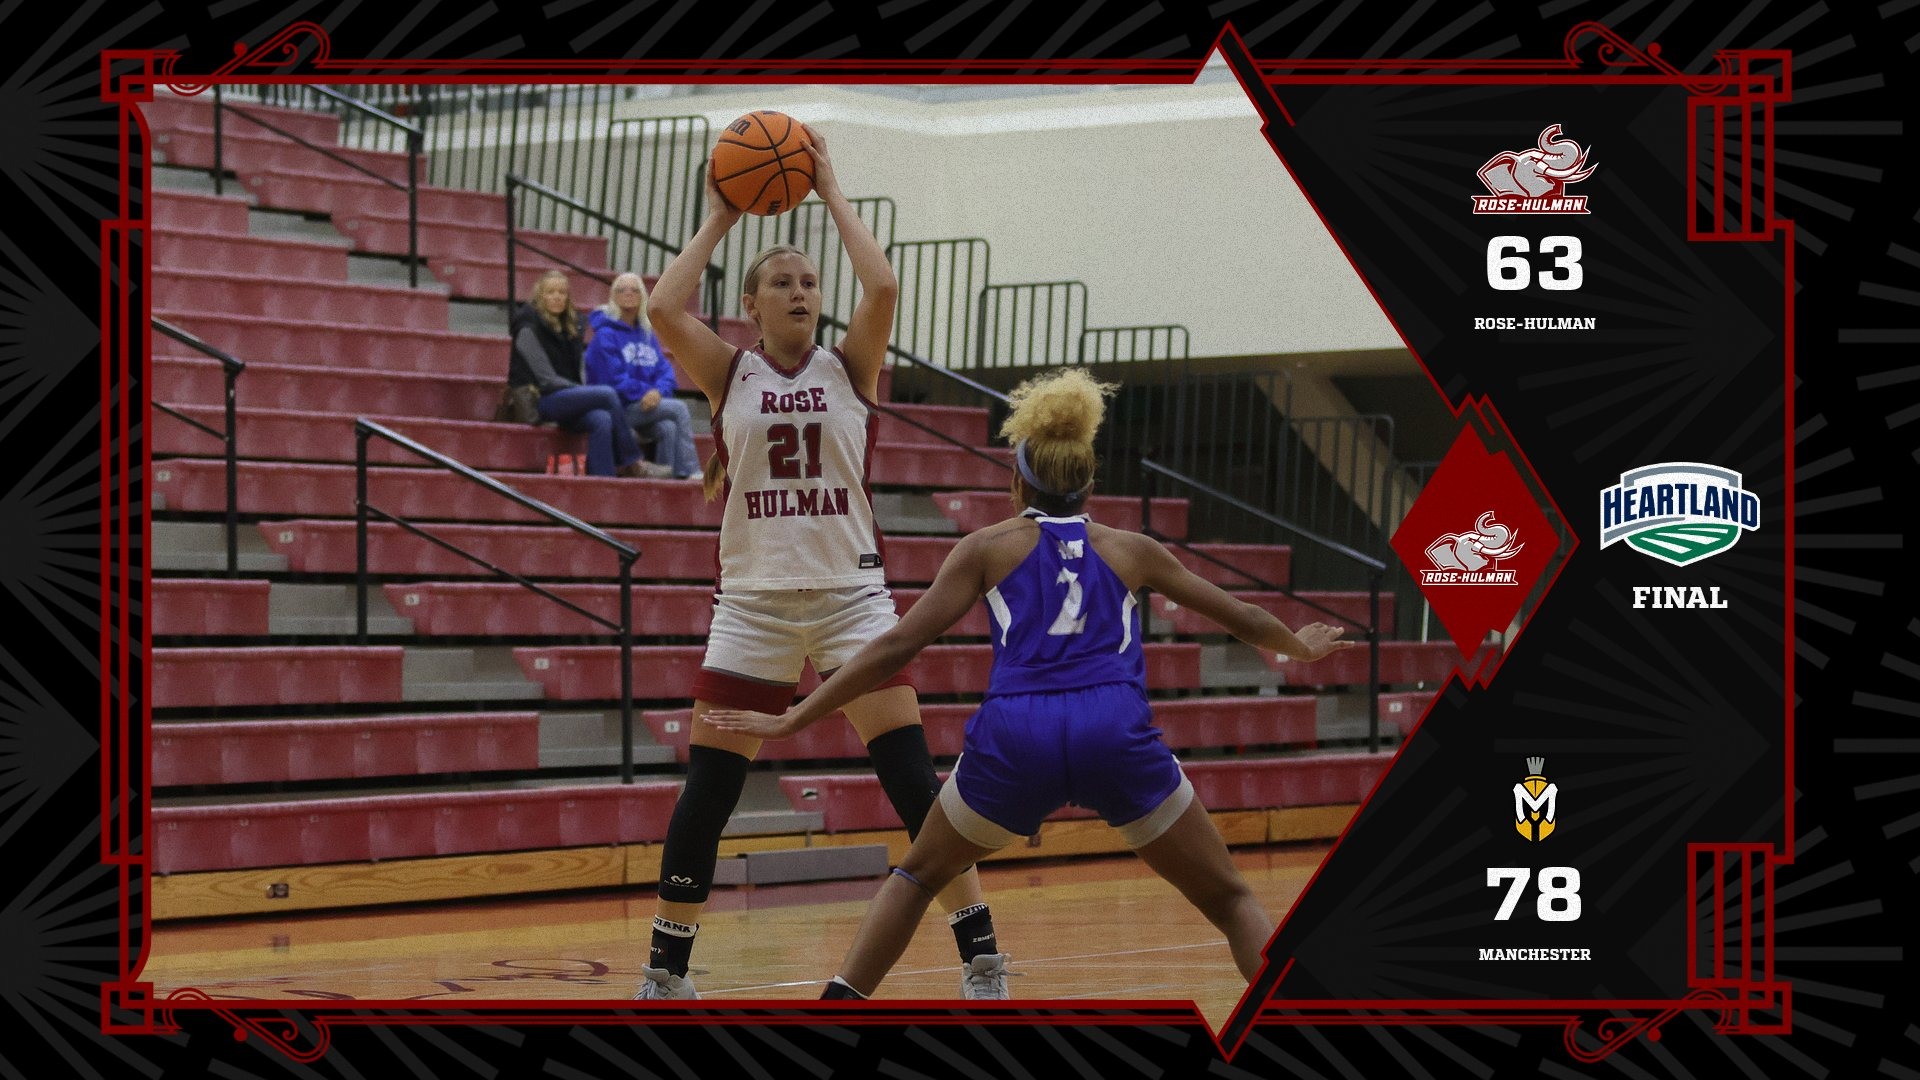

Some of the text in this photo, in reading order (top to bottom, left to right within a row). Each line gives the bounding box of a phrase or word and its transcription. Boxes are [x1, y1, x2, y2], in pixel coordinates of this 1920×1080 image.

[761, 388, 827, 414] ROSE
[767, 423, 822, 480] 21
[745, 488, 848, 519] HULMAN
[1048, 567, 1088, 635] 2
